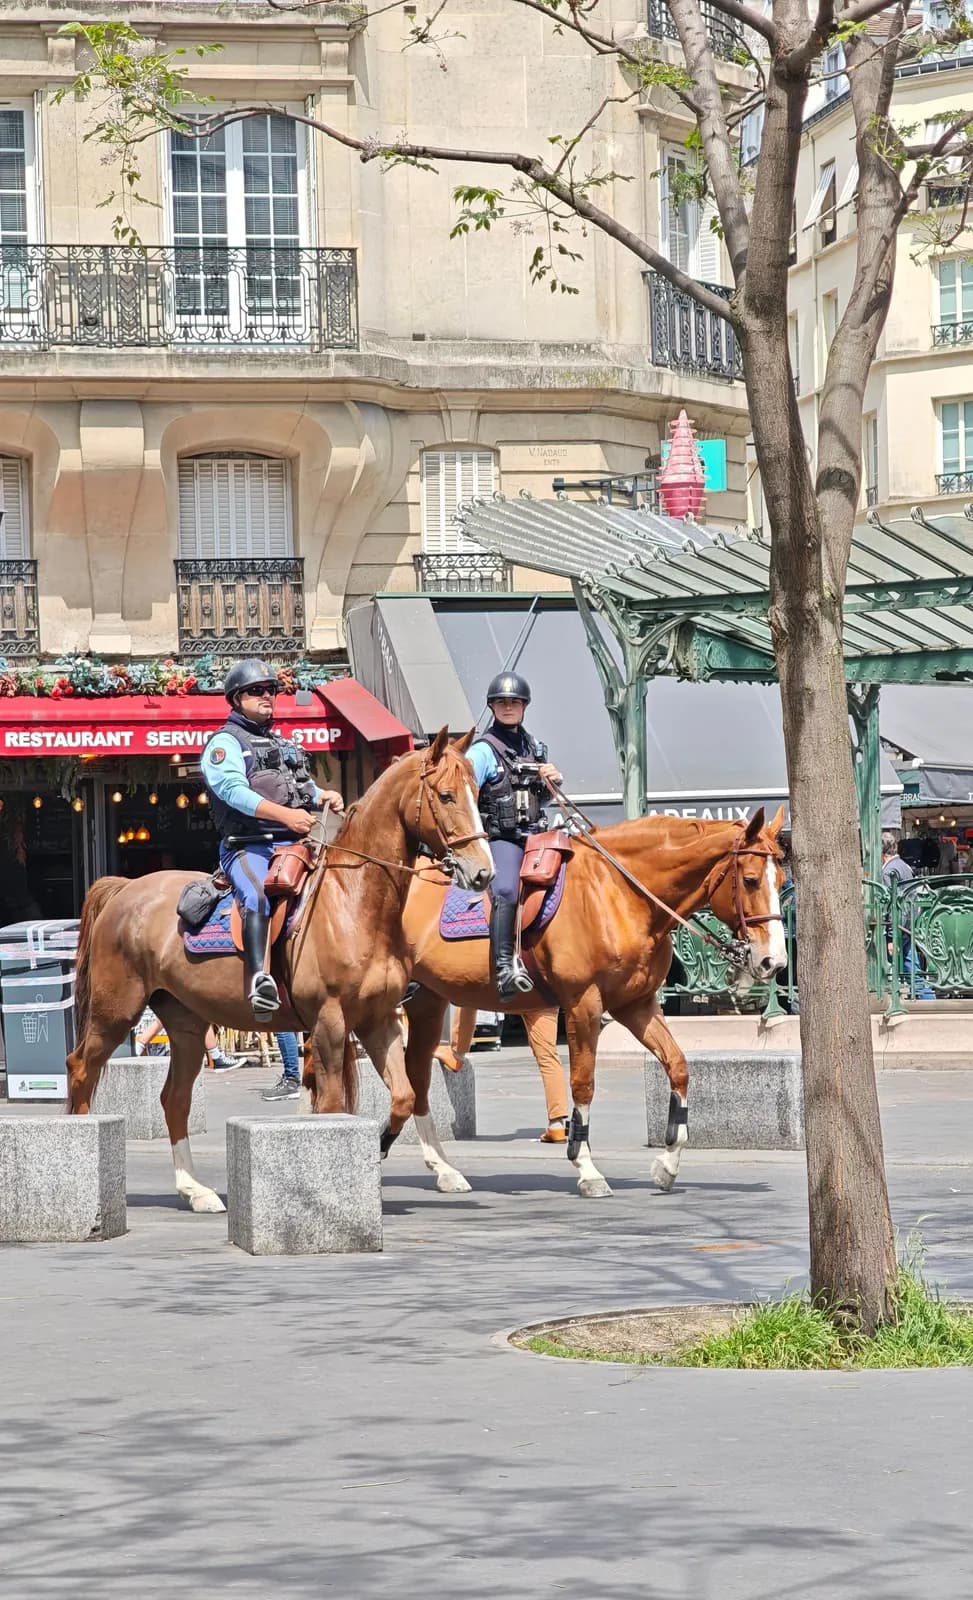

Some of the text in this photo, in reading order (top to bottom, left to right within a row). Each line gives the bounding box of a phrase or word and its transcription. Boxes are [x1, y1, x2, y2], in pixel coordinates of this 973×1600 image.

[5, 731, 134, 748] RESTAURANT
[146, 730, 214, 747] SERVIC
[291, 727, 342, 744] STOP
